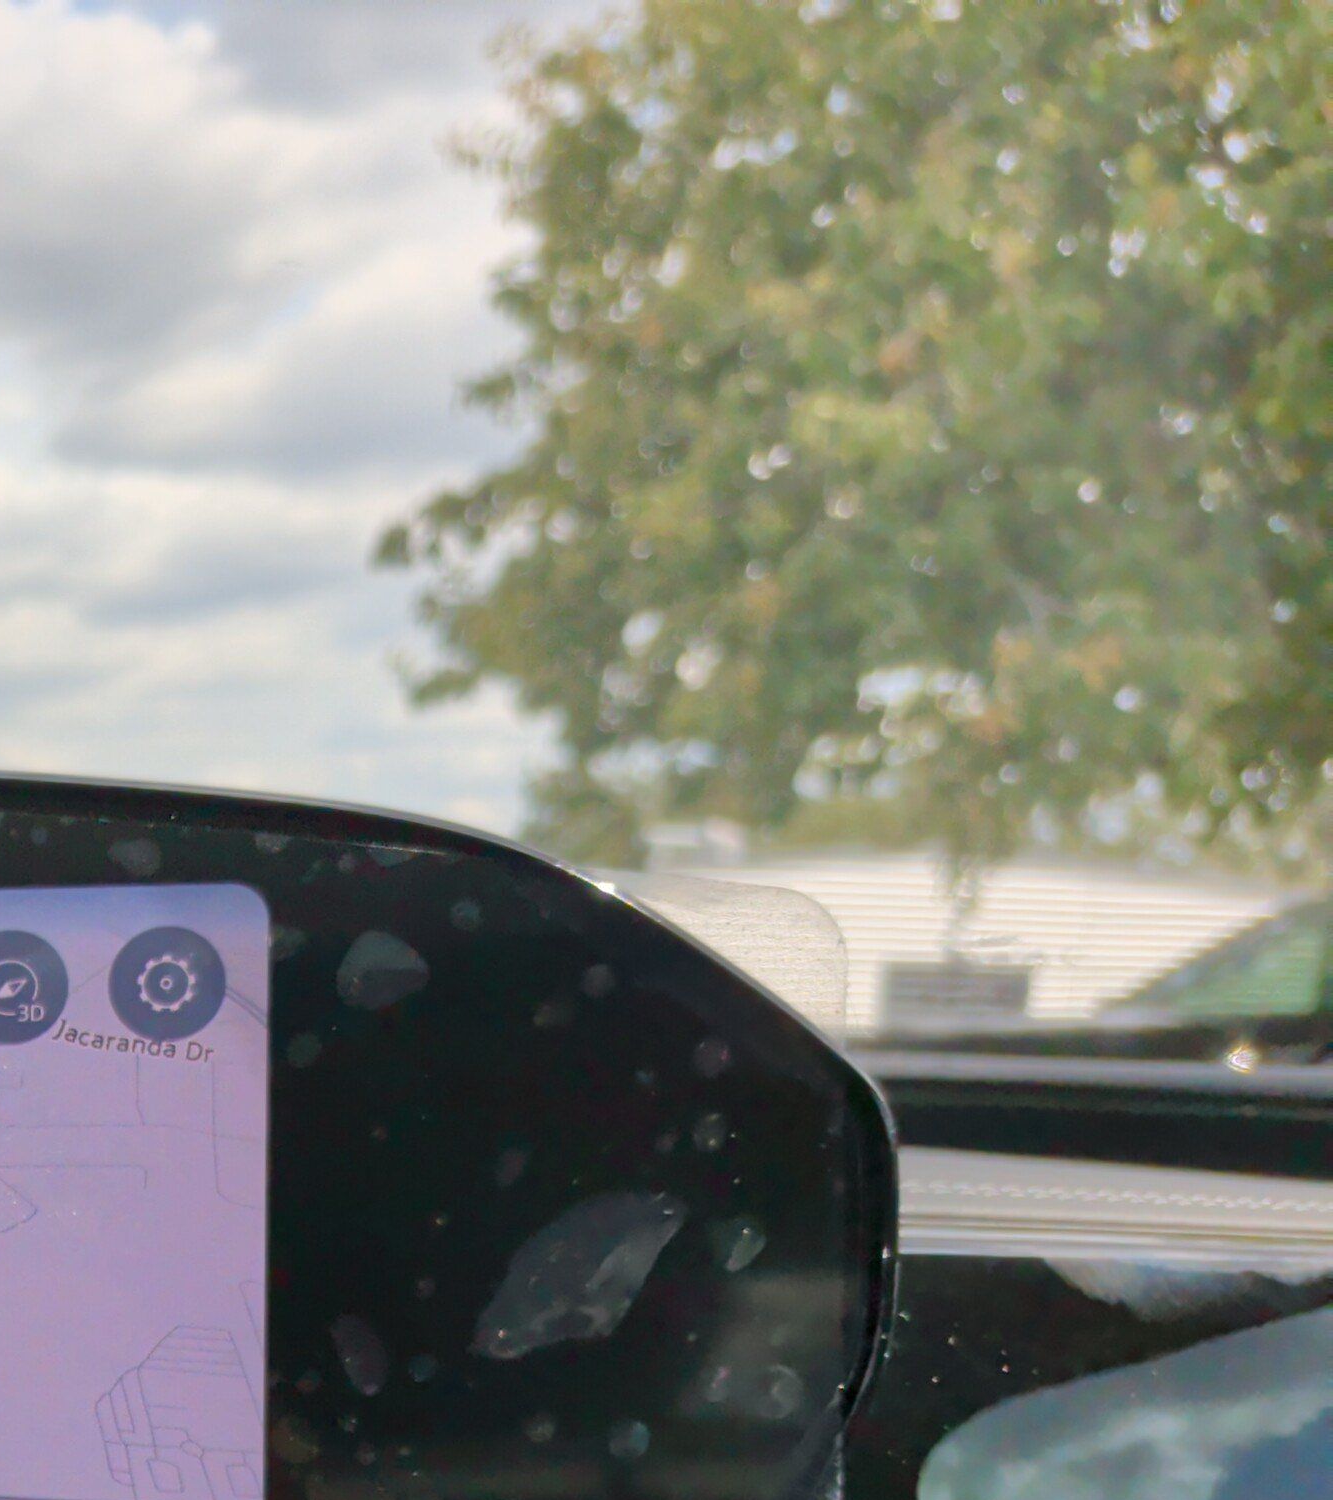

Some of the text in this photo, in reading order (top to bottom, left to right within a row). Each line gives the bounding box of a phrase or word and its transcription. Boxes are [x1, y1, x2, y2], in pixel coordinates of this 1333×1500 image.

[17, 1006, 44, 1023] 3D
[52, 1020, 215, 1063] Jacaranda Dr
